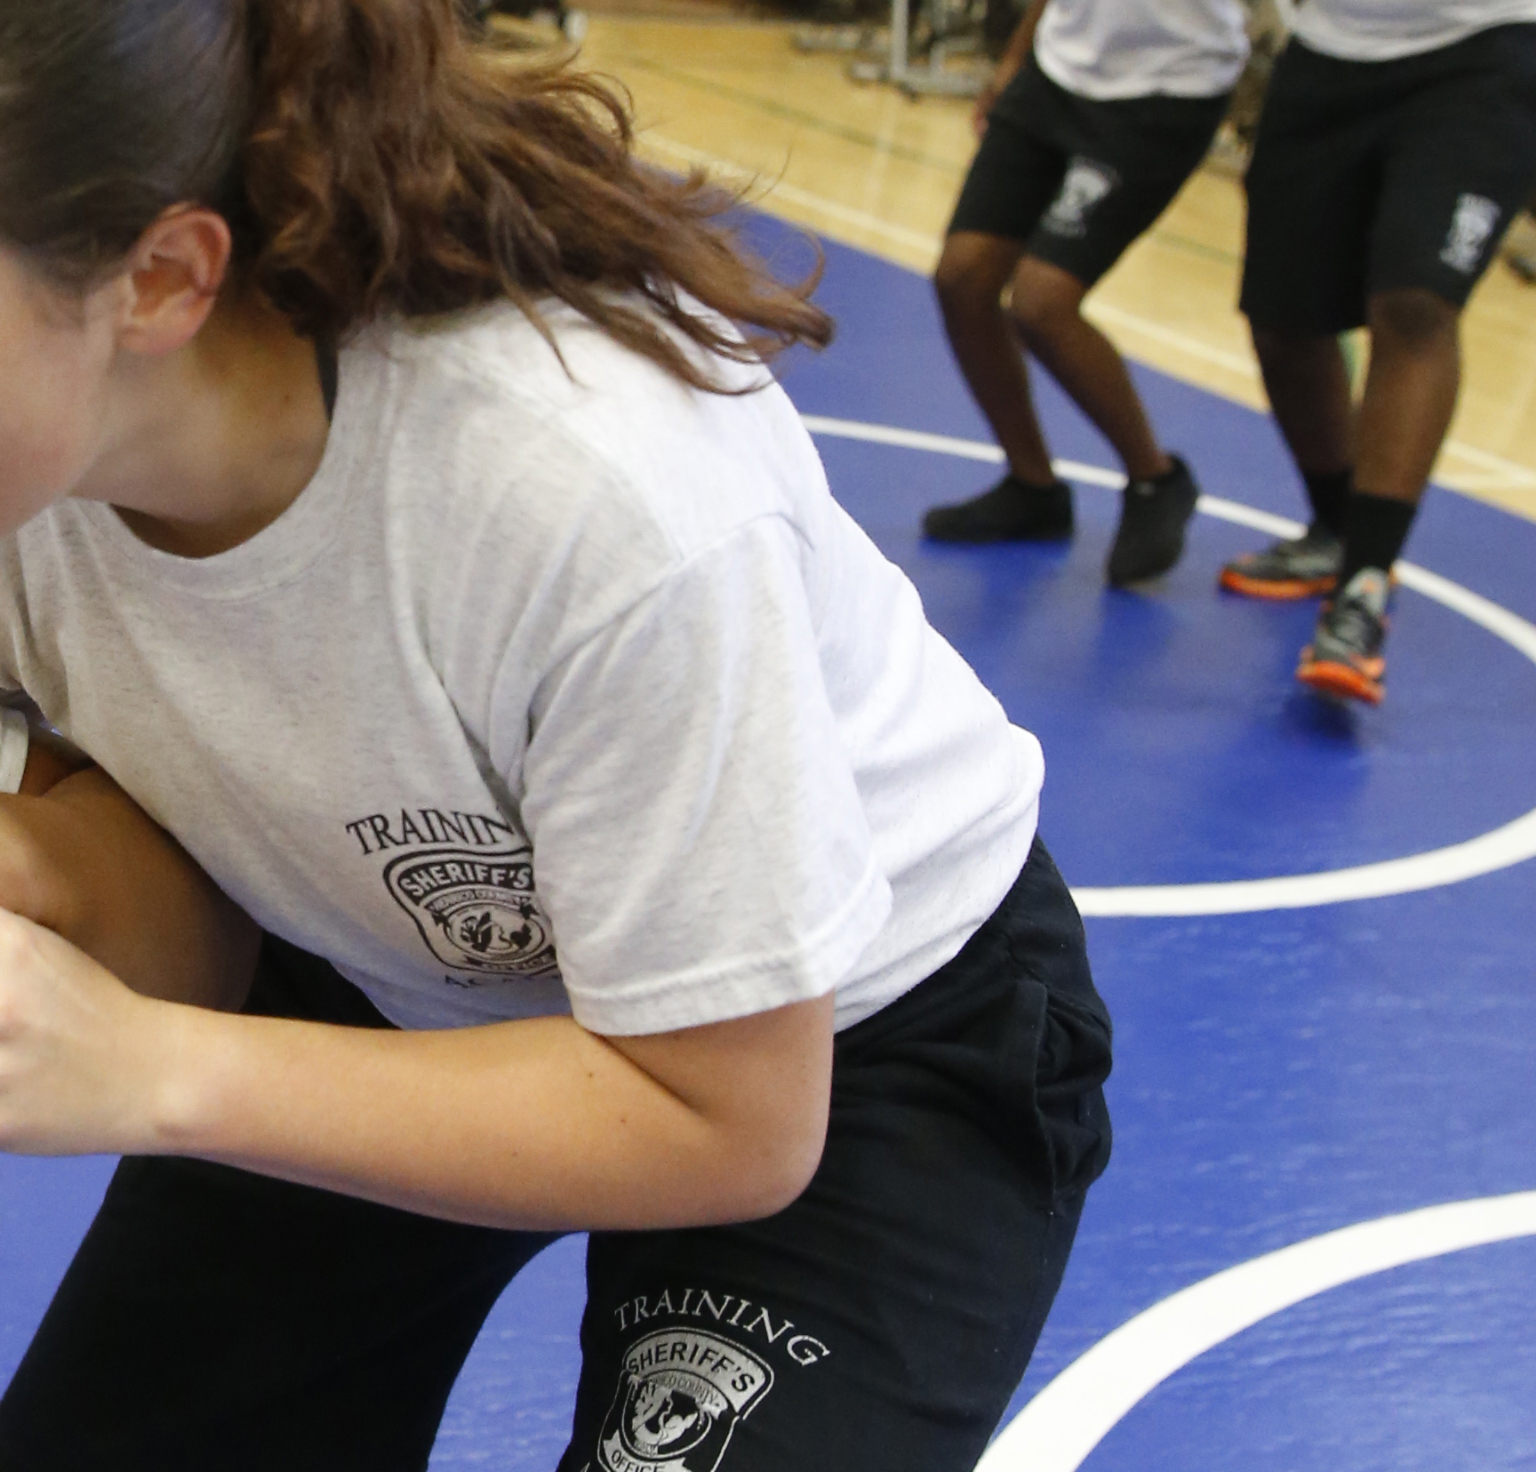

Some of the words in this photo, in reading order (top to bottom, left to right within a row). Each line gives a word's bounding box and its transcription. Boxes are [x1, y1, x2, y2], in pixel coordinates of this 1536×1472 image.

[345, 807, 516, 856] TRAININ
[400, 863, 531, 897] SHERIFF'S
[614, 1288, 831, 1367] TRAINING
[628, 1341, 756, 1393] SHERIFF'S
